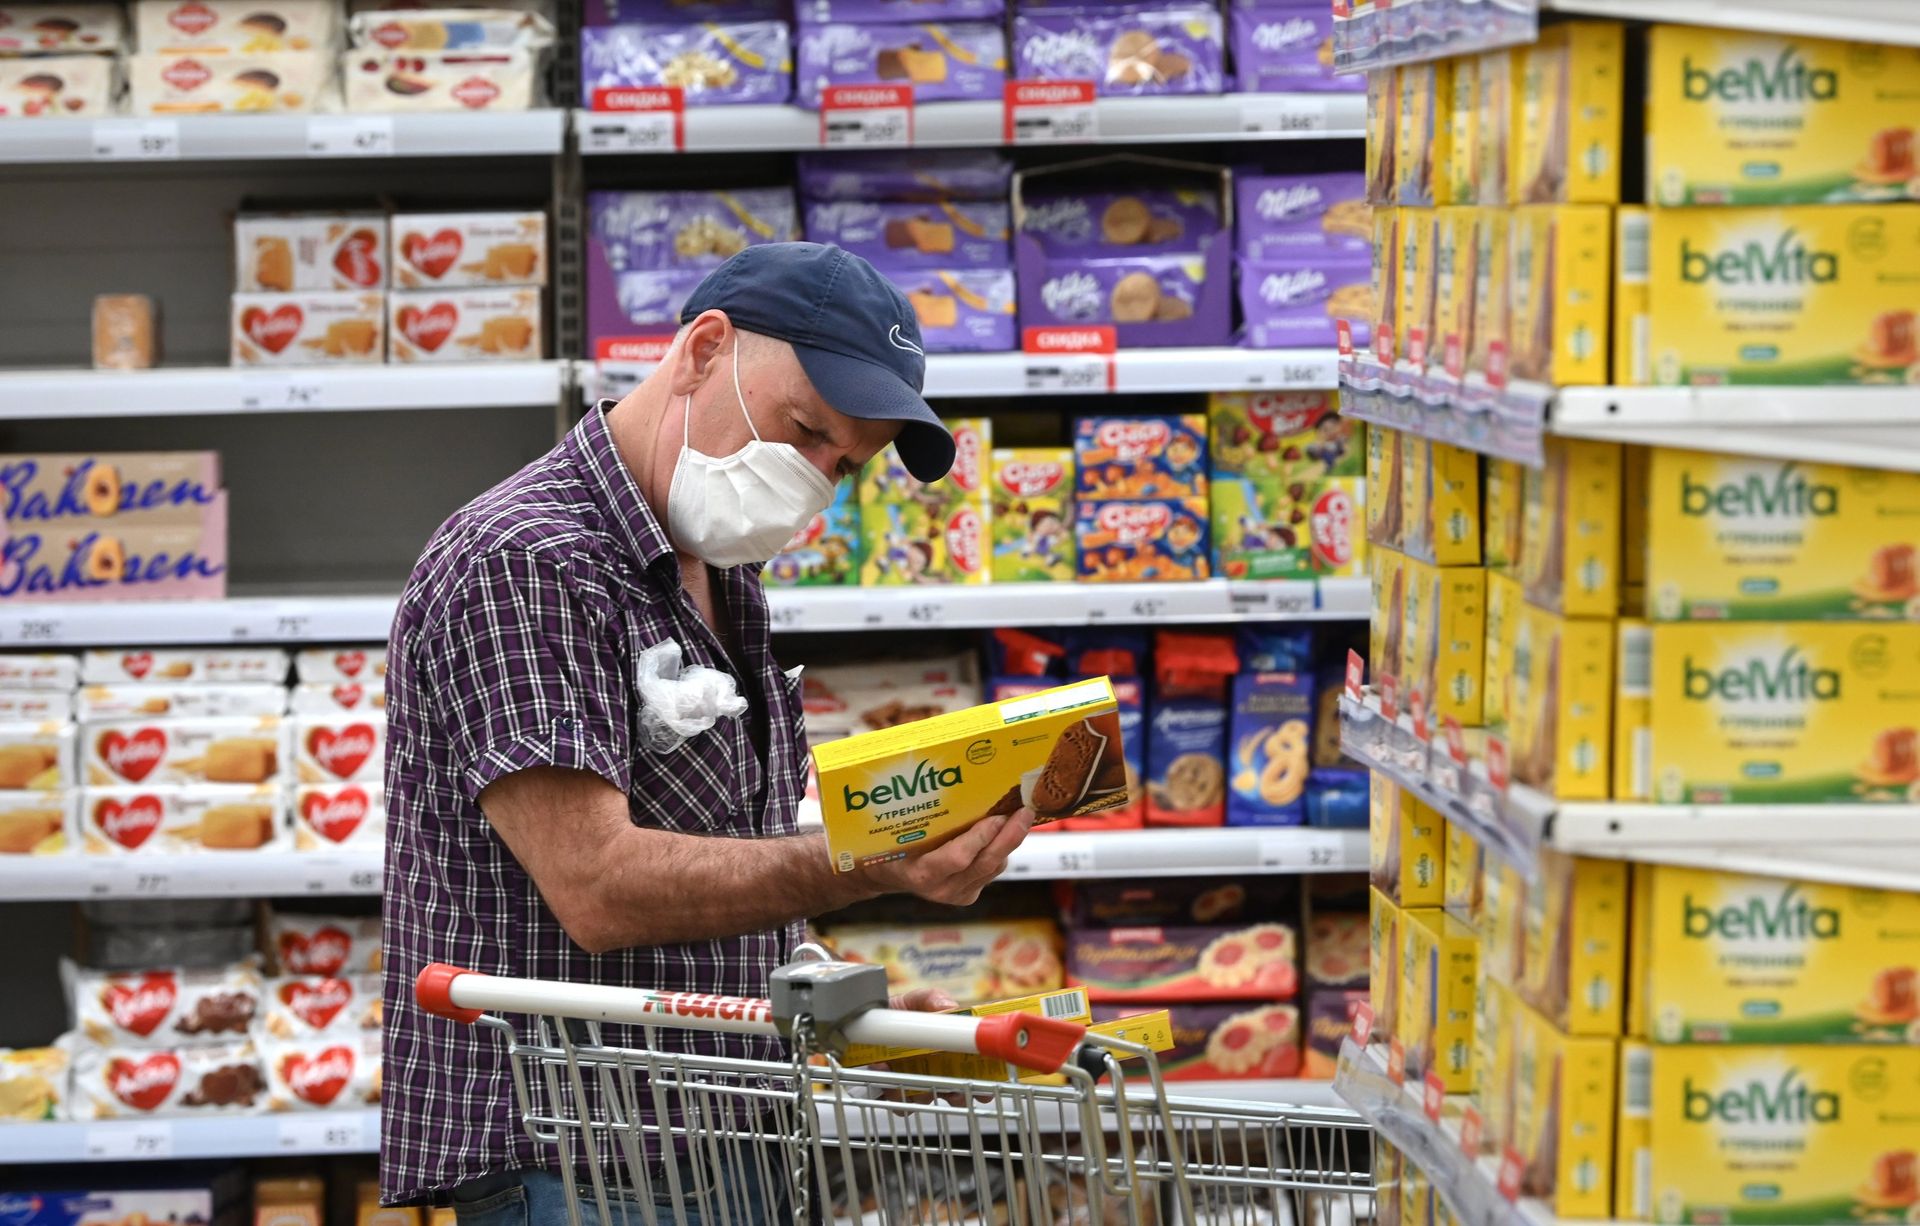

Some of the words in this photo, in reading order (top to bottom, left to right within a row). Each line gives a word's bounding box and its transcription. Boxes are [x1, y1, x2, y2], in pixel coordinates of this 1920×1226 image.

[1682, 46, 1839, 101] belVita
[1680, 228, 1838, 284] belVita
[1037, 331, 1102, 350] СКИДКА
[1682, 461, 1839, 517] belVita
[1684, 644, 1841, 701] belVita
[1012, 739, 1019, 747] 5
[843, 758, 964, 812] belVita
[874, 798, 941, 822] УТРЕННЕЕ
[869, 824, 894, 835] КАКАО
[902, 809, 949, 827] ЙОГУРТОВОЙ
[1684, 883, 1841, 939] belVita
[1684, 1066, 1841, 1123] belVita
